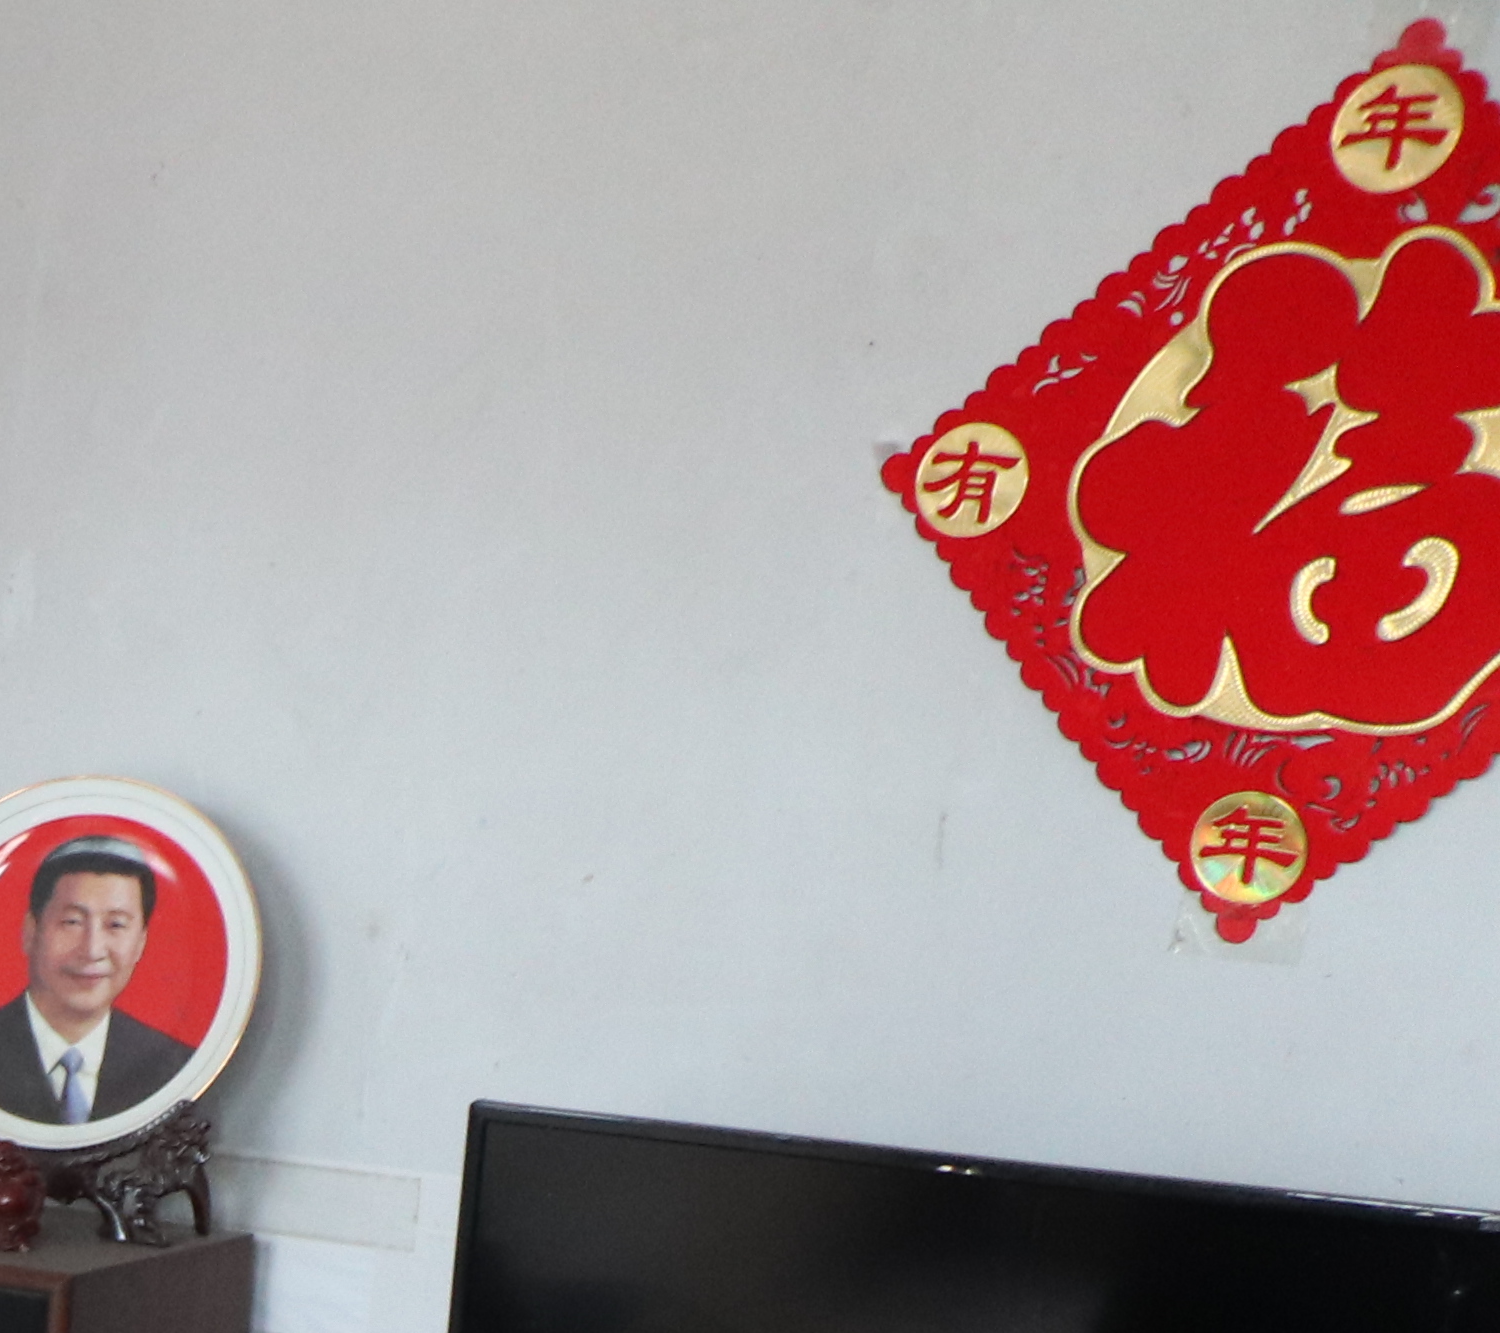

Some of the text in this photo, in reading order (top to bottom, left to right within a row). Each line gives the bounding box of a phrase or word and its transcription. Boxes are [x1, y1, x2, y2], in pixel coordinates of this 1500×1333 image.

[1337, 84, 1449, 171] 年
[923, 439, 1020, 526] 有
[1198, 806, 1304, 884] 年
